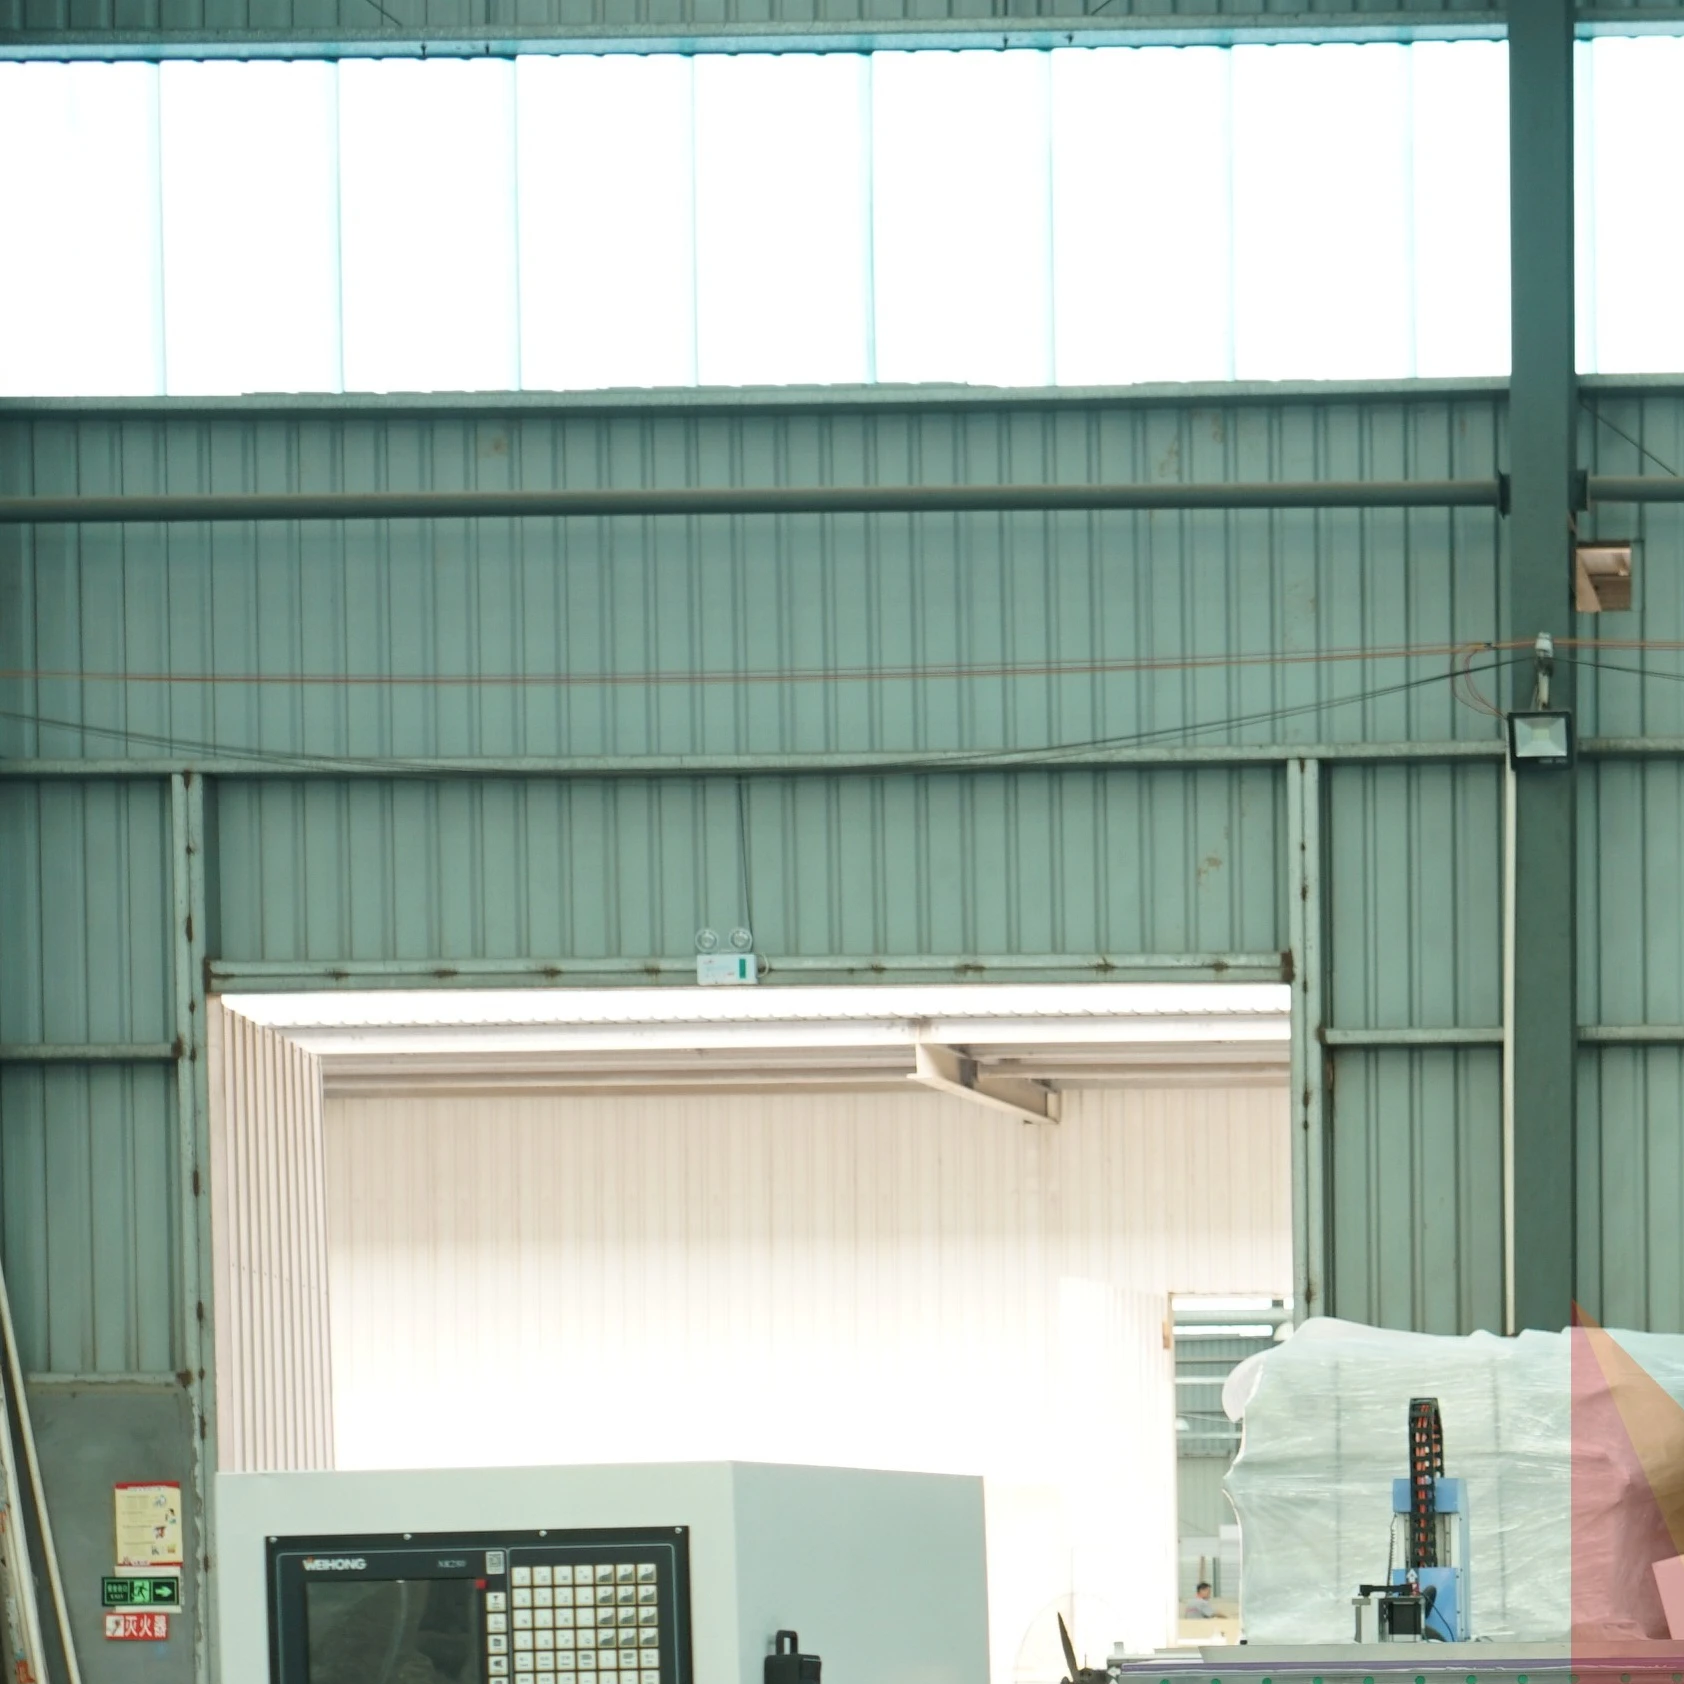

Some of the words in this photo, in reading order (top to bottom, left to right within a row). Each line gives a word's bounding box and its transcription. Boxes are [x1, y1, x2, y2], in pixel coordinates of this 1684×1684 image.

[303, 1558, 367, 1571] WEIHONG
[124, 1614, 167, 1638] 灭火器
